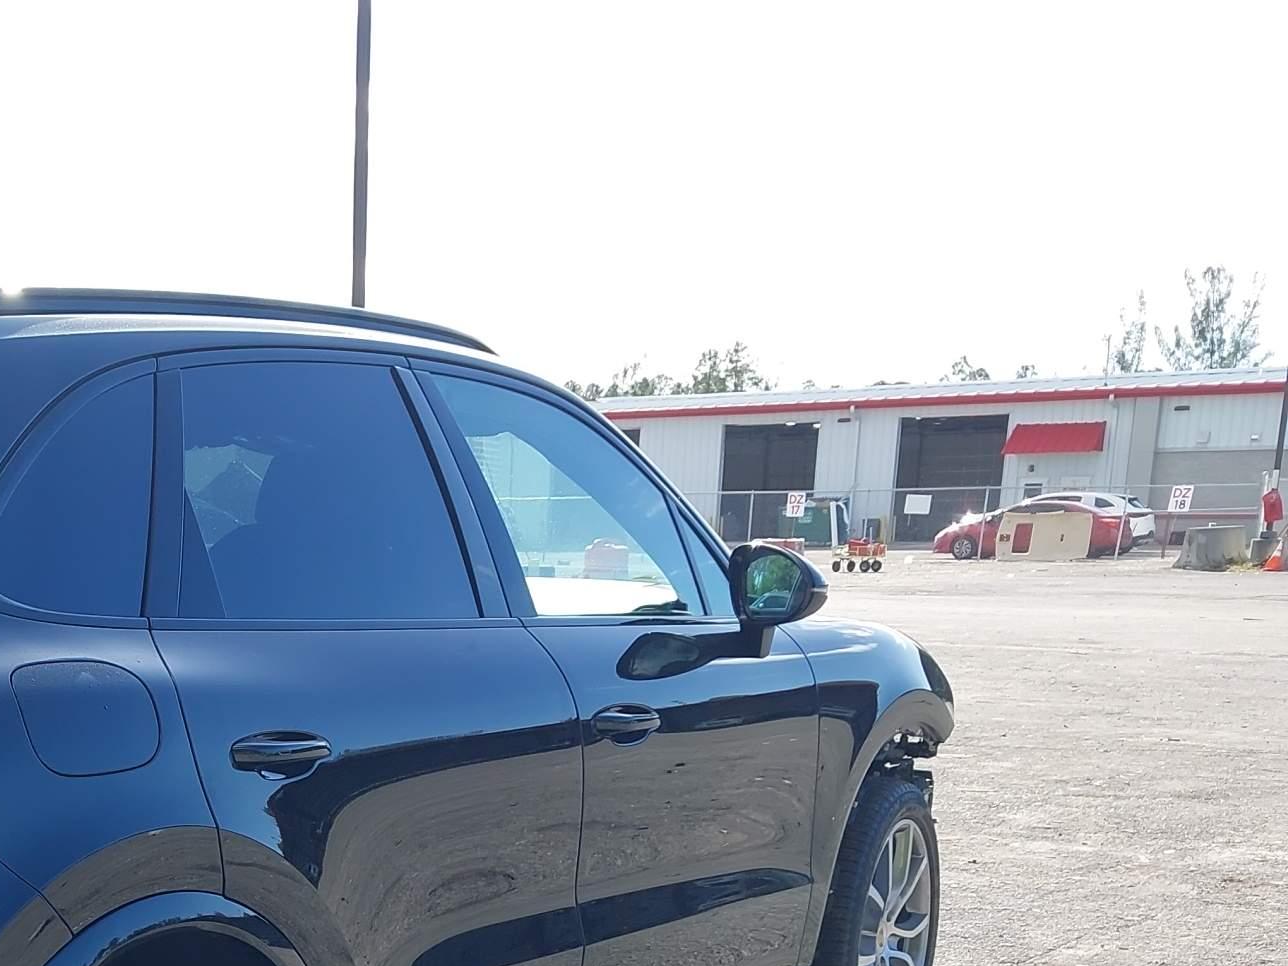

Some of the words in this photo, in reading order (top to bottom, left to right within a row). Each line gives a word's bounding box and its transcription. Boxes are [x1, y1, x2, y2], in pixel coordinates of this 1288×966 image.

[1173, 487, 1192, 498] DZ
[789, 494, 804, 505] DZ
[1174, 499, 1186, 510] 18
[792, 505, 801, 515] 17
